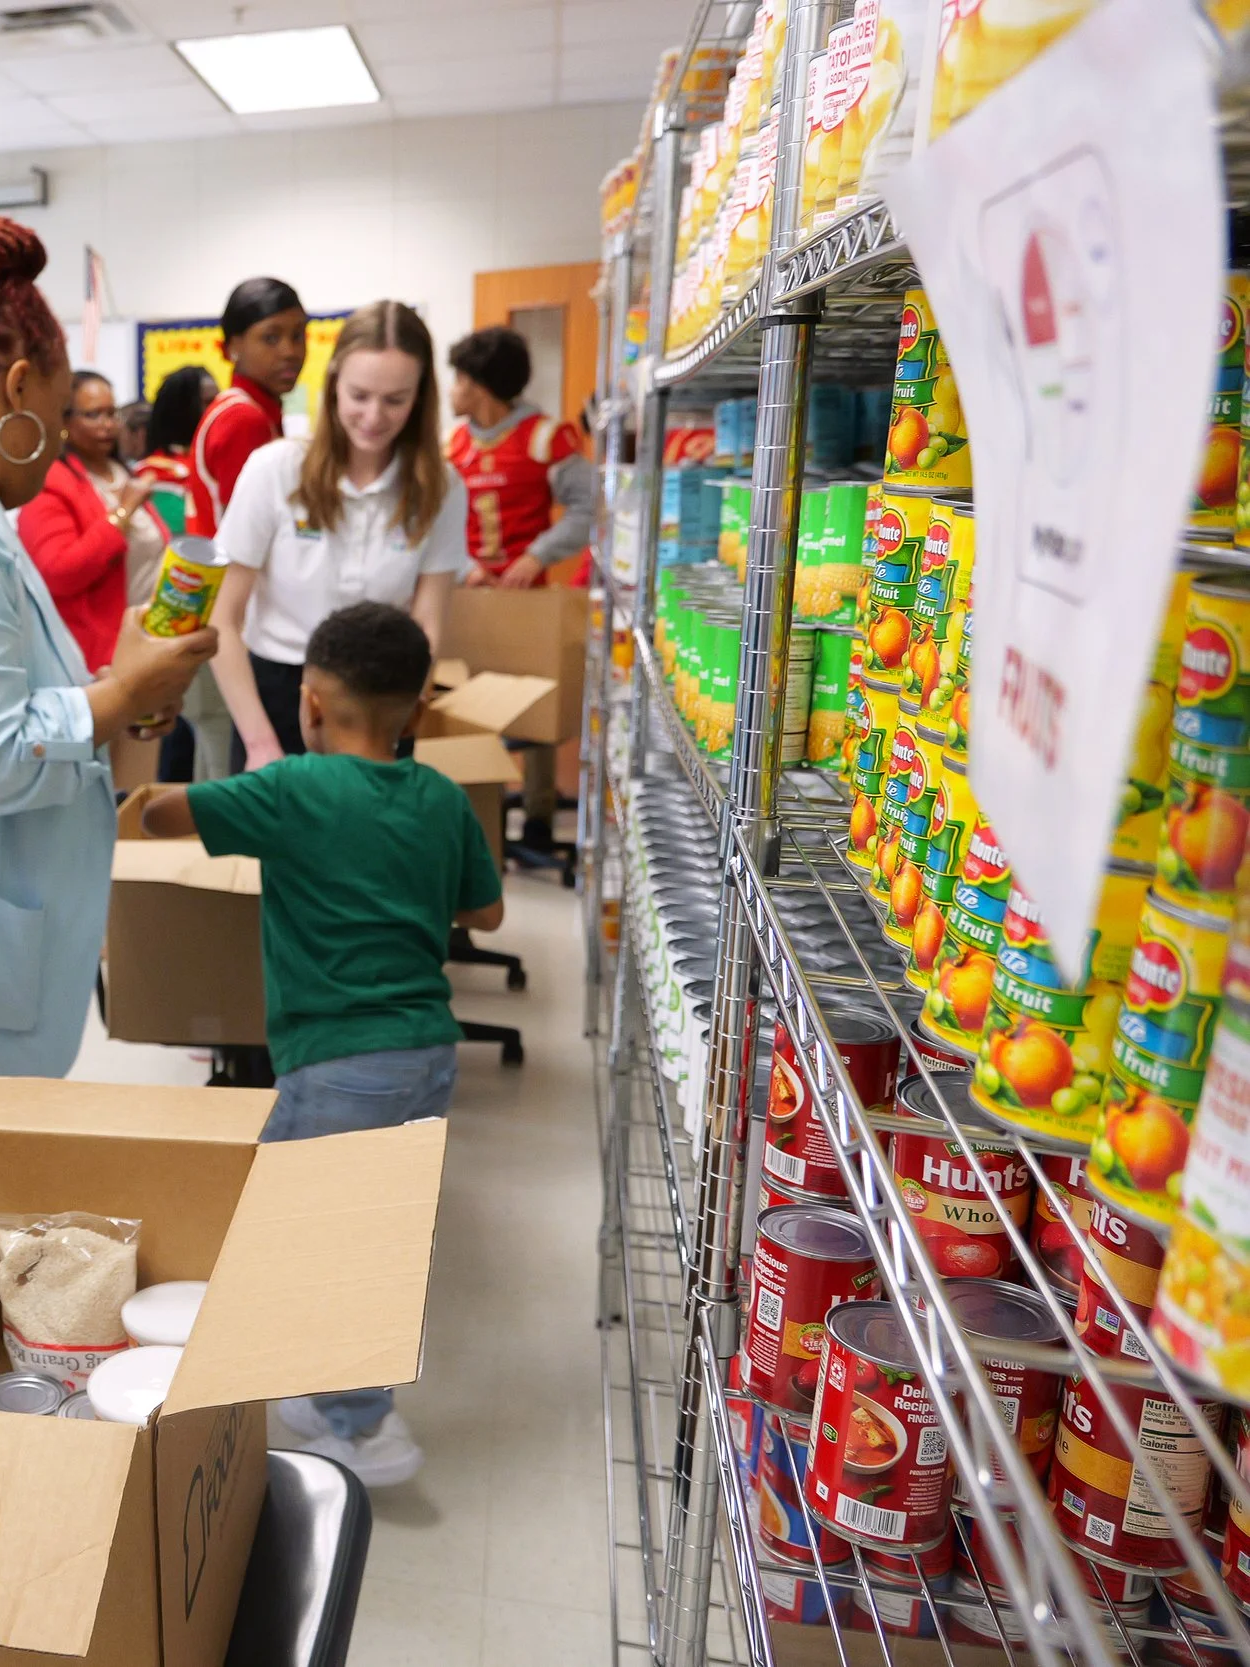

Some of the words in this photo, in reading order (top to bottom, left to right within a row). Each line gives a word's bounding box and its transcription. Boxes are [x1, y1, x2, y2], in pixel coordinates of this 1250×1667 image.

[876, 584, 900, 600] Fruit
[1181, 741, 1228, 777] Fruit
[957, 912, 996, 945] Fruit
[1006, 976, 1053, 1014] Fruit
[1124, 1046, 1171, 1088] Fruit
[30, 1351, 80, 1371] Grain
[1139, 1437, 1178, 1451] Calories
